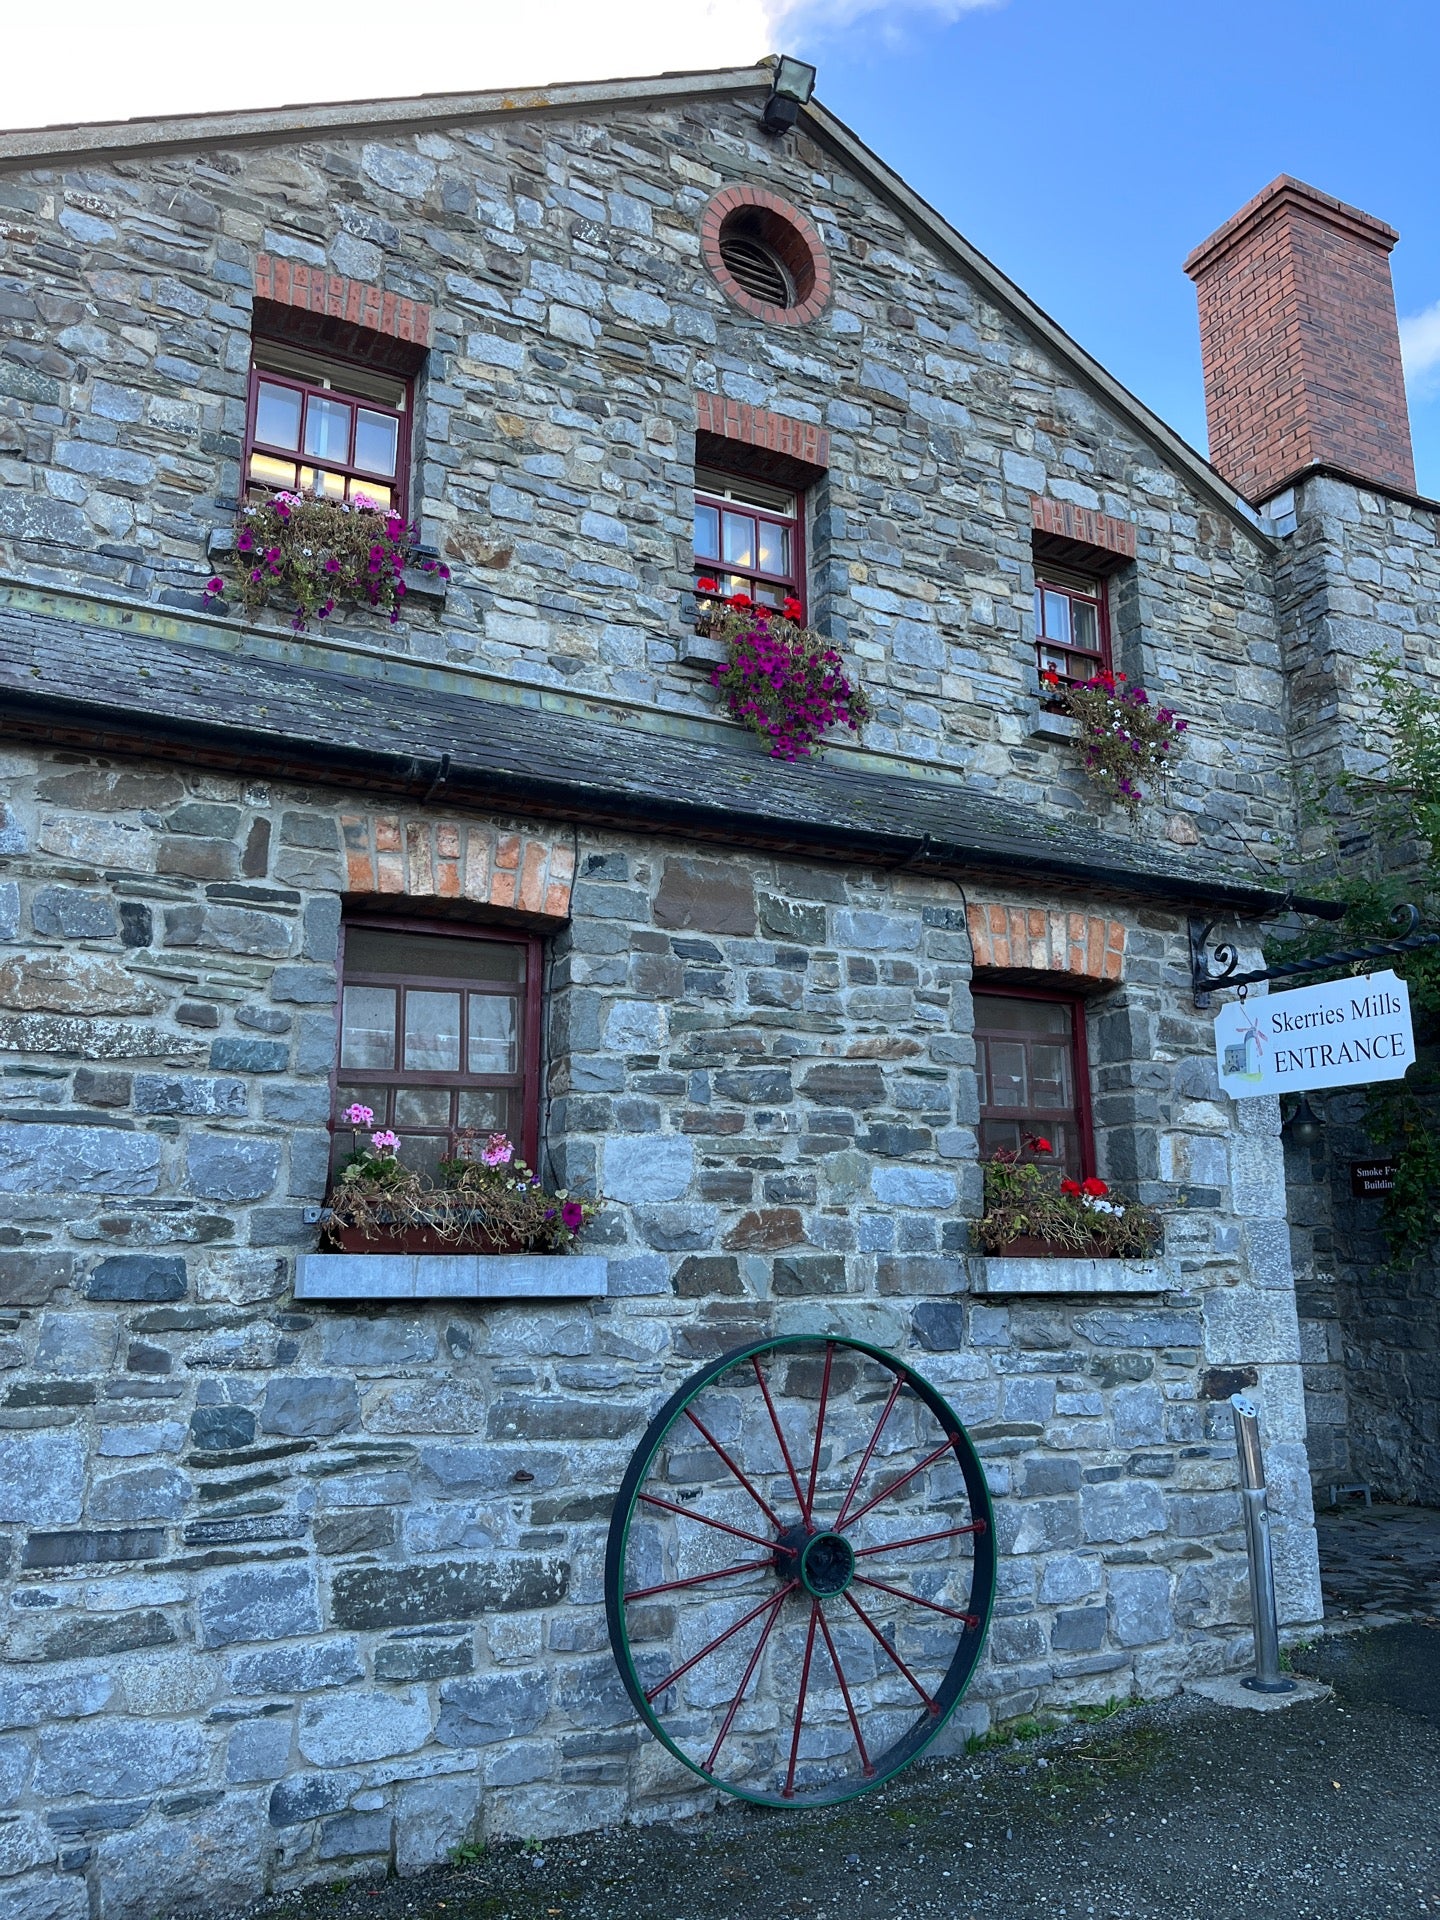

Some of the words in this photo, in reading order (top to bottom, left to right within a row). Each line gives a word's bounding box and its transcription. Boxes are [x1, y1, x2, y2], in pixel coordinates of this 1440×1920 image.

[1272, 1005, 1344, 1033] Skerries
[1351, 993, 1401, 1020] Mills
[1274, 1033, 1405, 1073] ENTRANCE
[1356, 1167, 1383, 1177] Smoke
